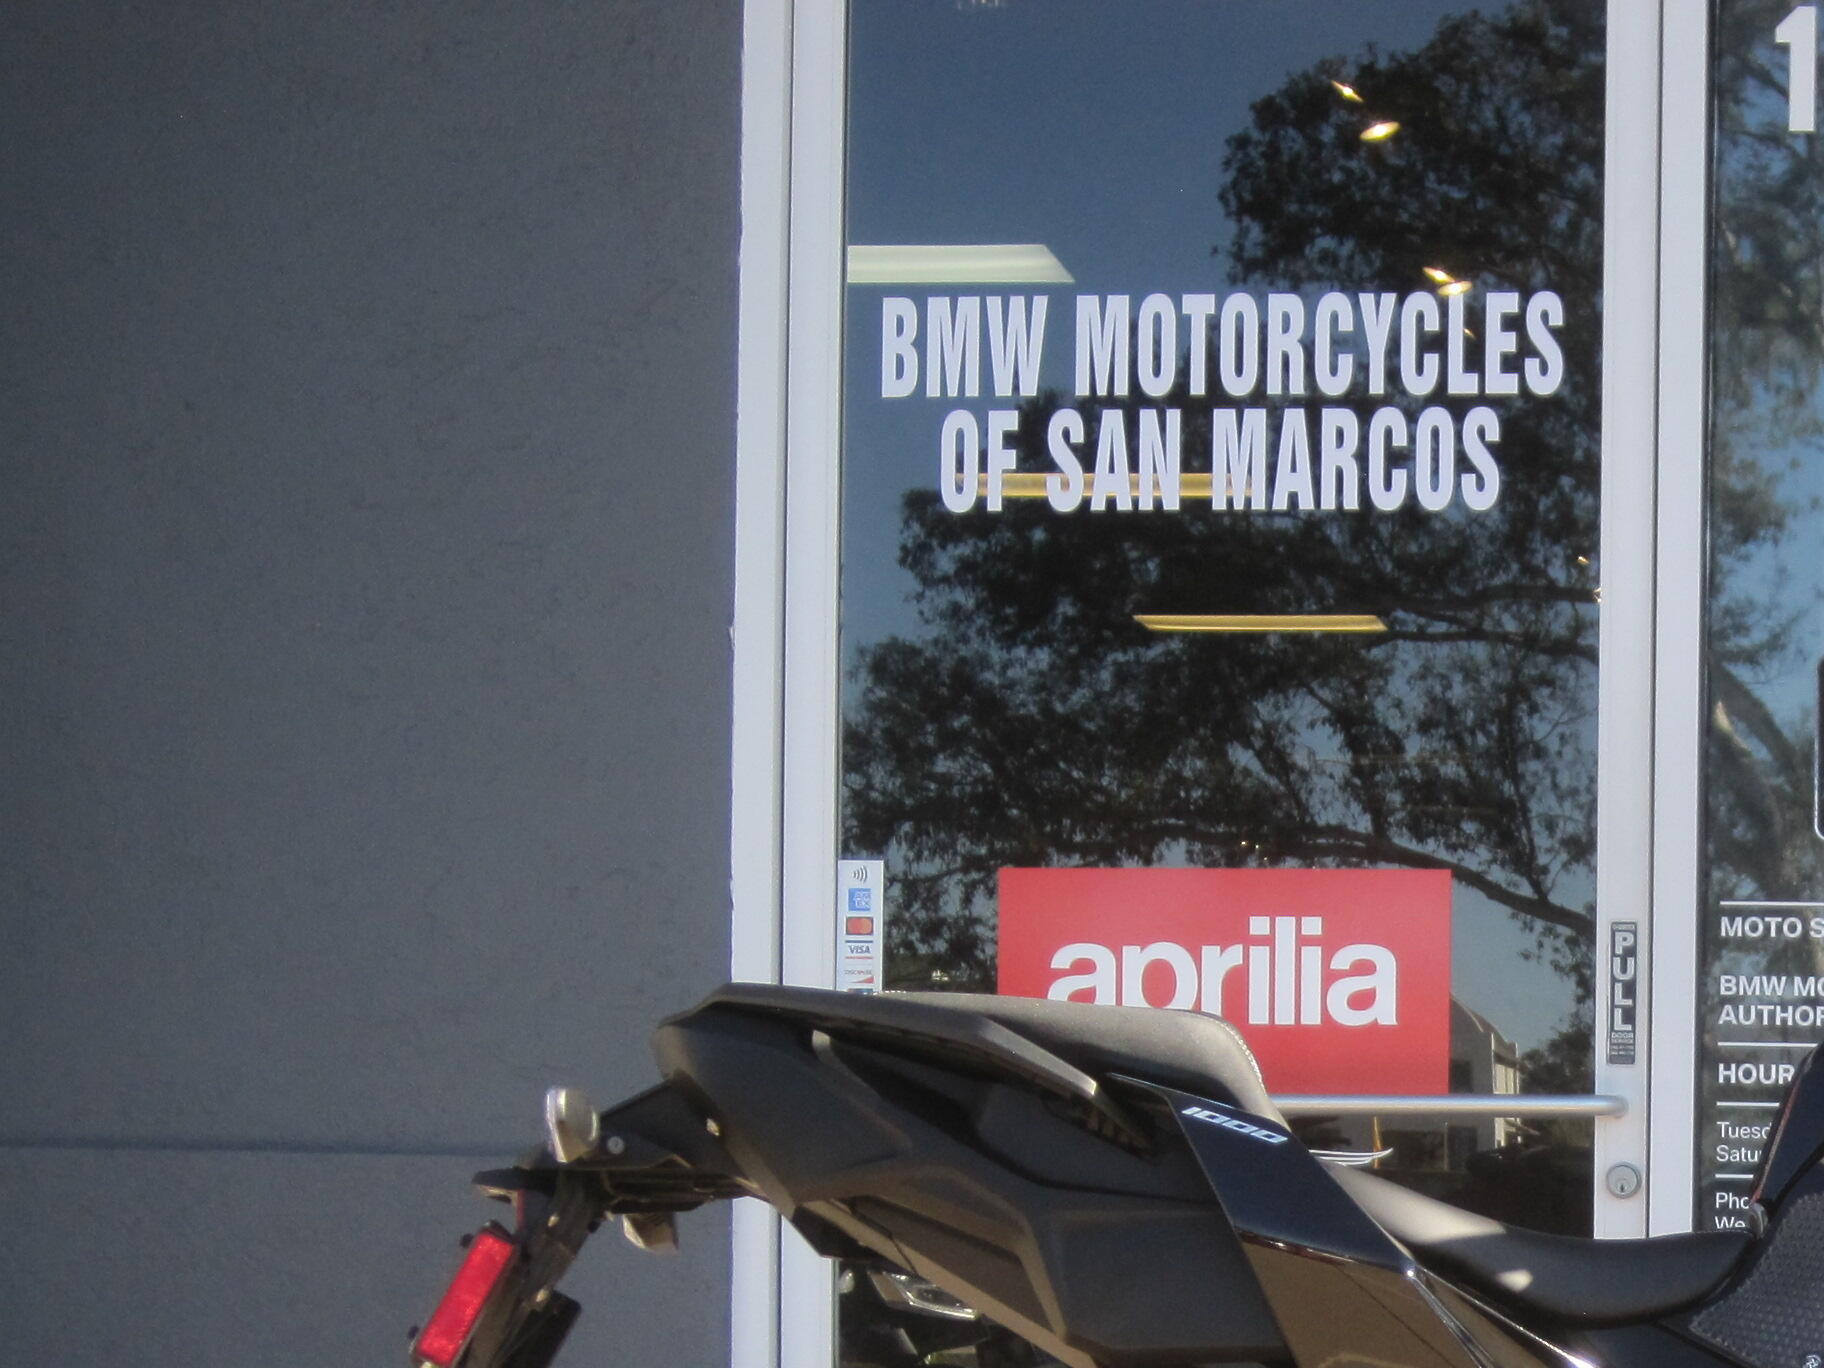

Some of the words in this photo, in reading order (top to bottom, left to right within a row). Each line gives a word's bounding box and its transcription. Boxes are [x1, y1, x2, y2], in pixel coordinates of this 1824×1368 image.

[881, 295, 1049, 400] BMW
[1075, 290, 1565, 398] MOTORCYCLES
[940, 409, 1019, 514] OF
[1045, 408, 1181, 514] SAN
[1211, 406, 1503, 513] MARCOS
[1720, 916, 1802, 938] MOTO
[1047, 916, 1398, 1026] aprilia
[1612, 931, 1635, 1031] PULL
[1719, 975, 1786, 997] BMW
[1181, 1106, 1288, 1143] 1000
[1716, 1144, 1762, 1163] Satu
